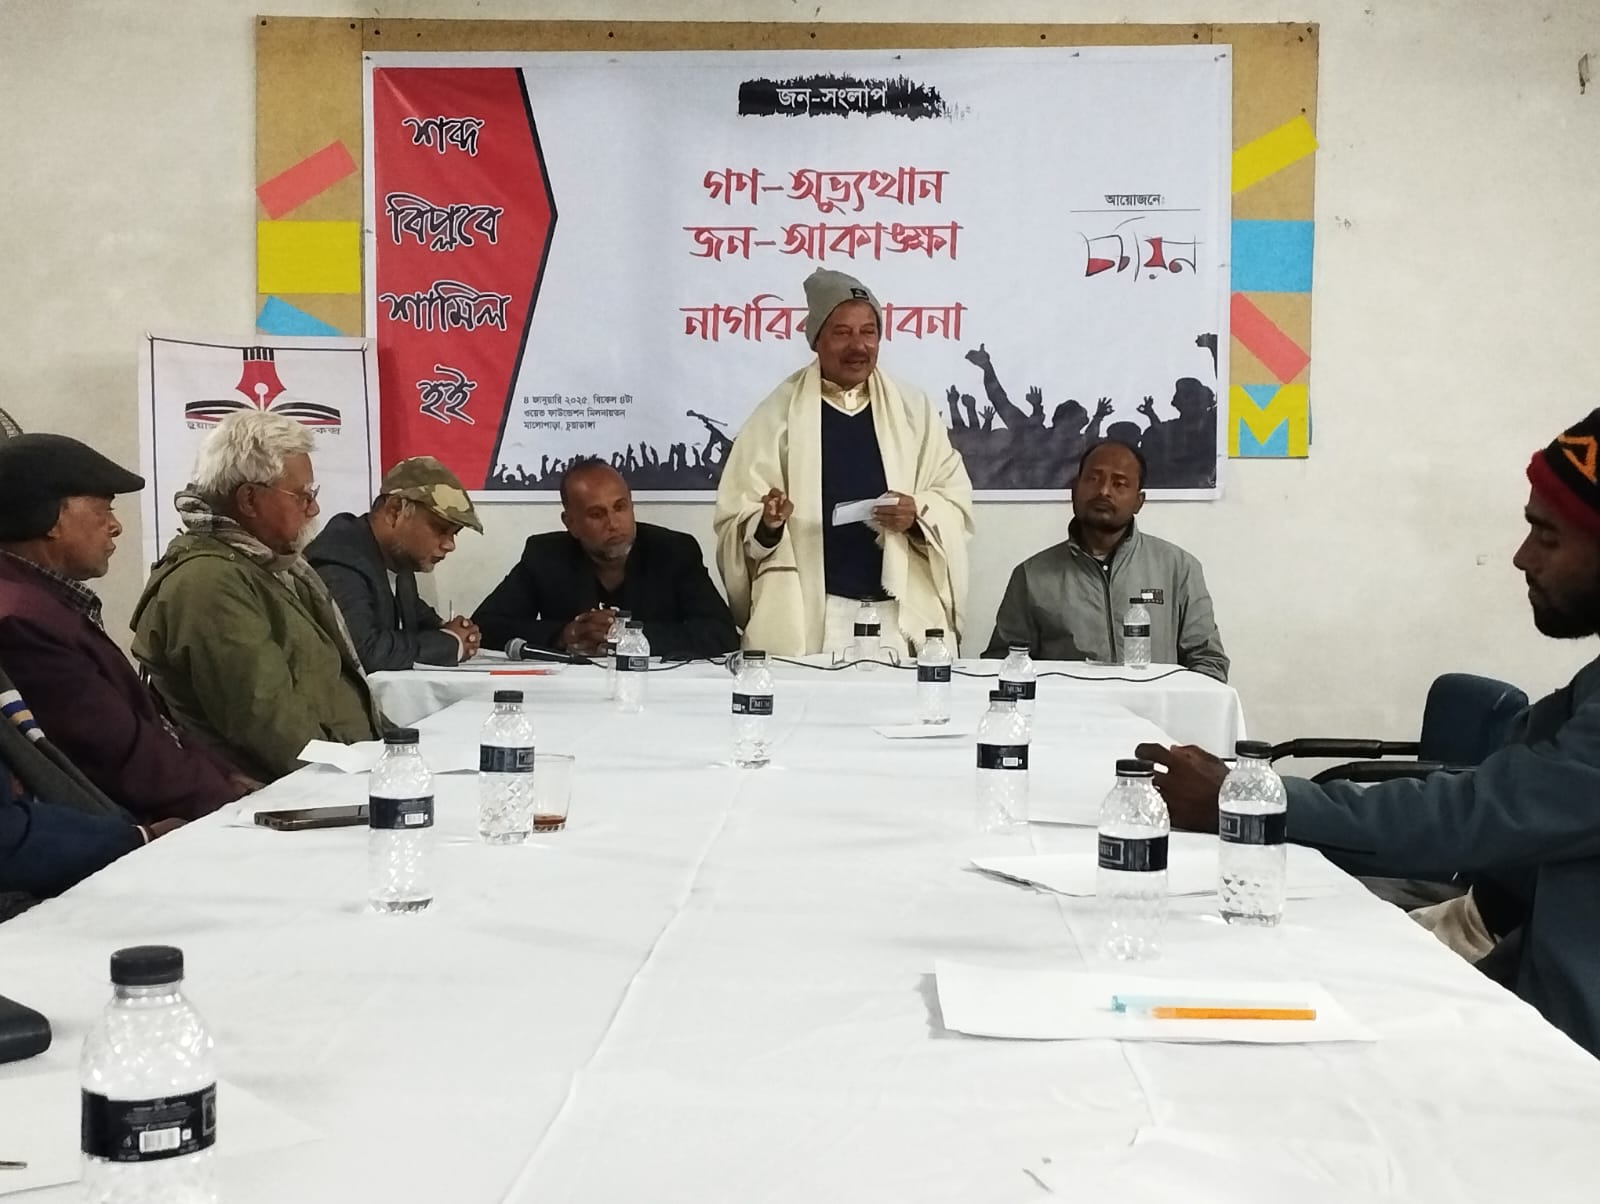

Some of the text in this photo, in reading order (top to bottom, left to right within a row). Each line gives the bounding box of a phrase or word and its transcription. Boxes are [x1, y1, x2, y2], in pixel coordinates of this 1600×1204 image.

[776, 85, 888, 110] জন-সংলাপ
[385, 191, 504, 252] বিপ্লবে
[379, 279, 512, 333] শামিল
[416, 363, 478, 425] হই
